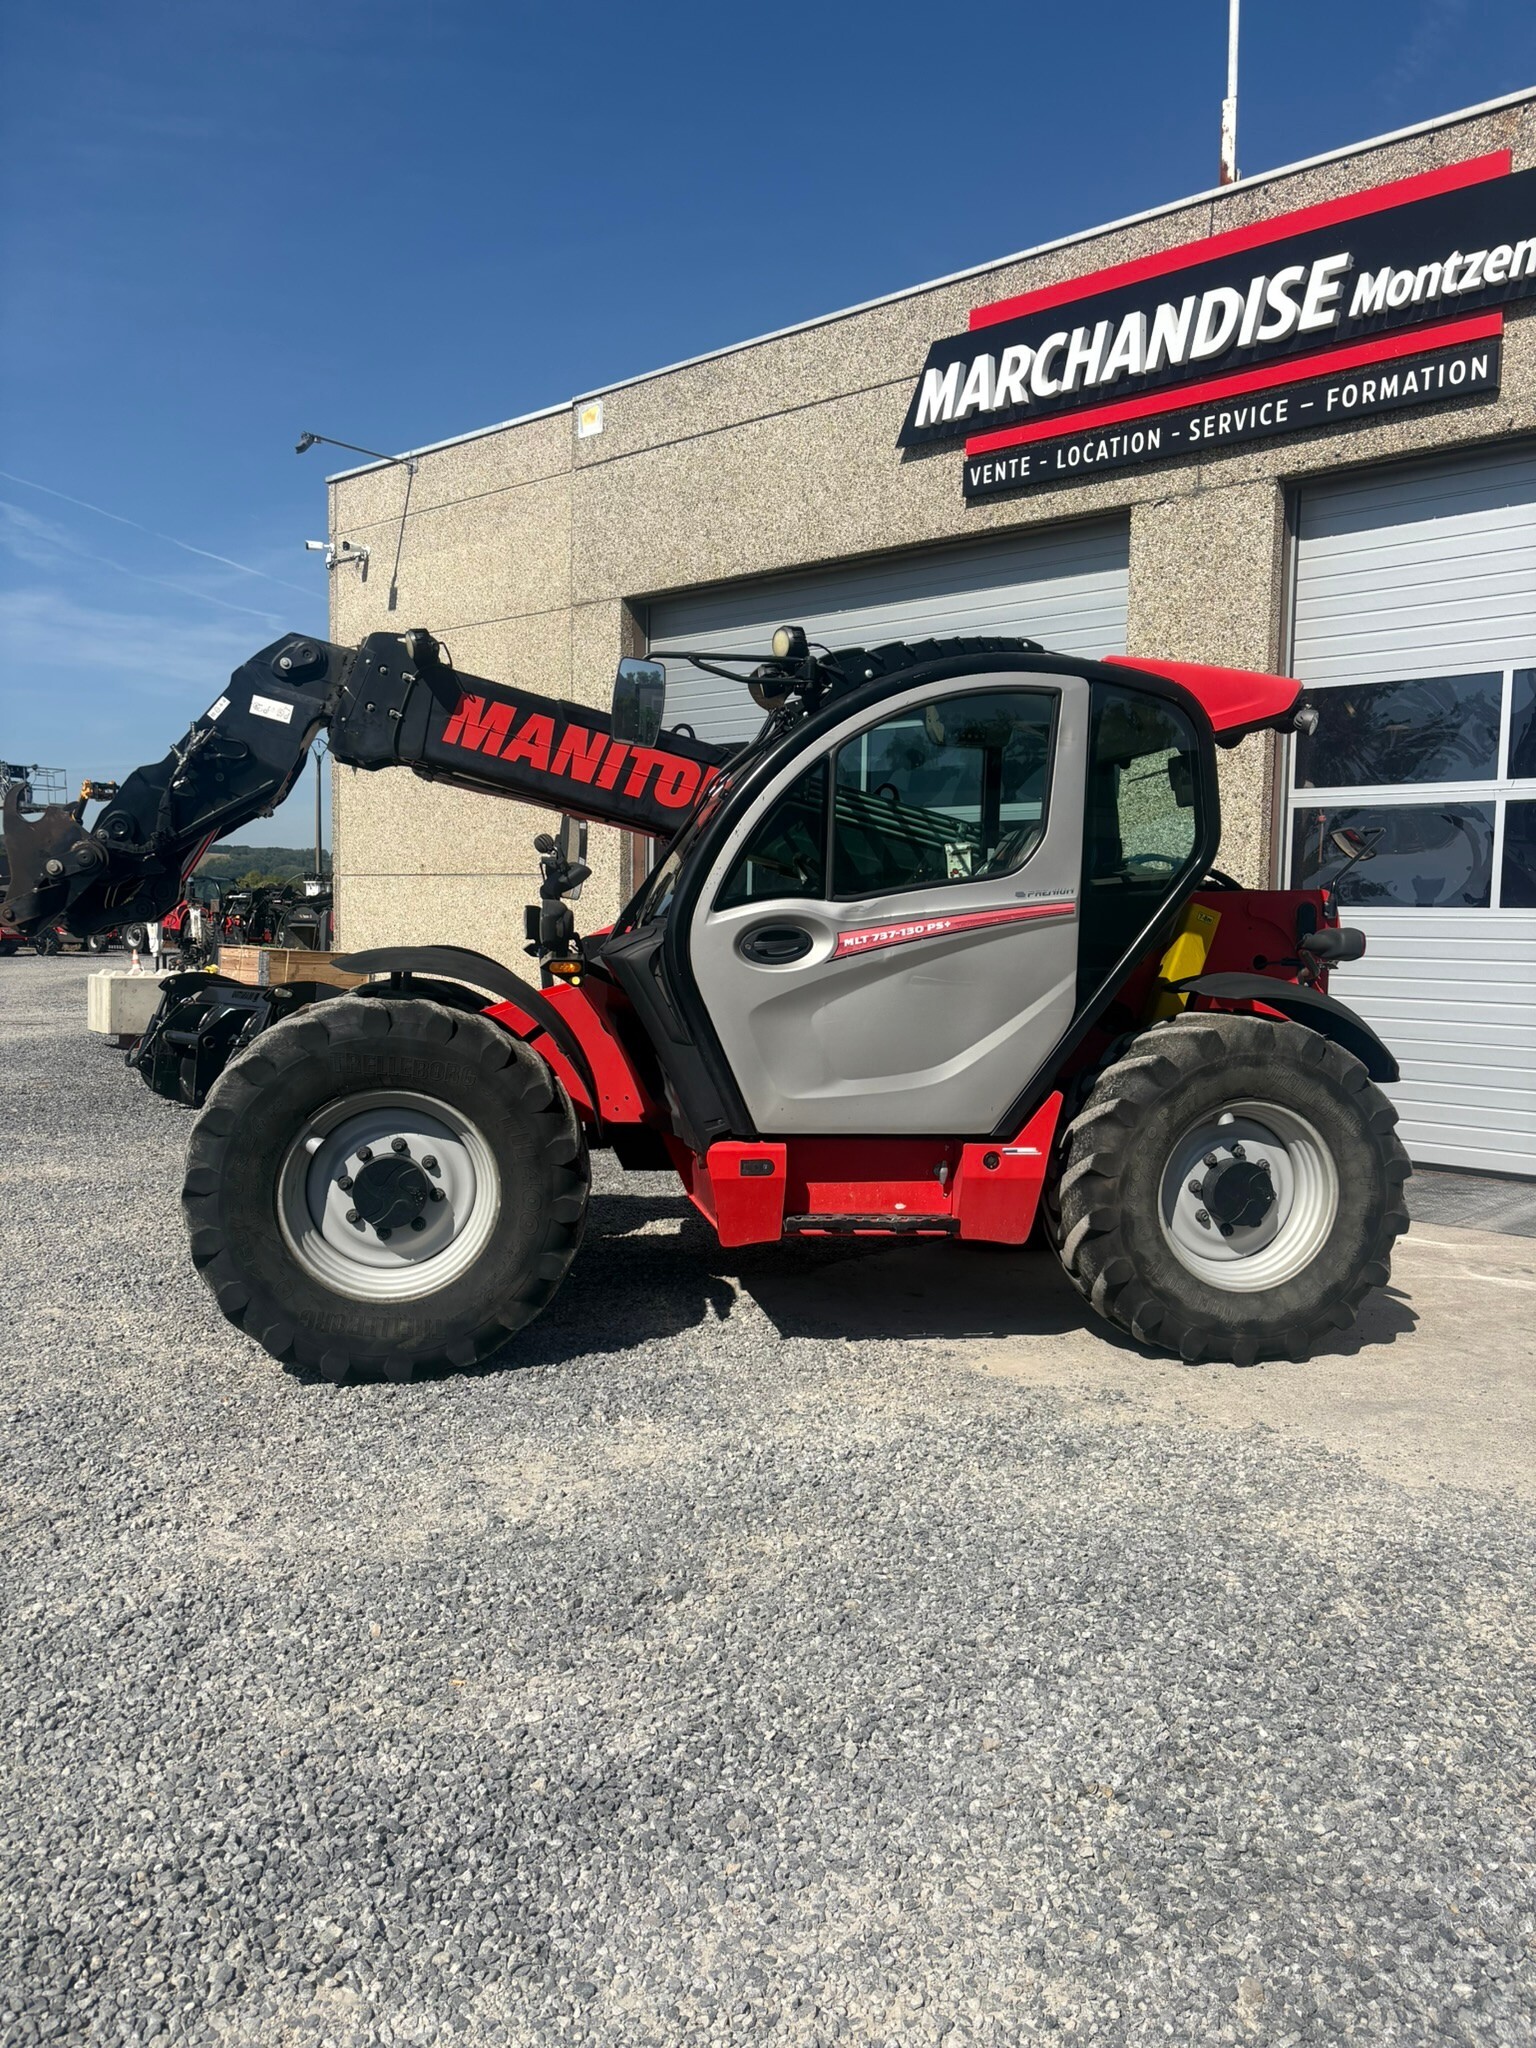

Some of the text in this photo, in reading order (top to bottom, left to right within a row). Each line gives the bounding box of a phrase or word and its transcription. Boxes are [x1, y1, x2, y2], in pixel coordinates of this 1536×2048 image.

[914, 237, 1536, 428] MARCHANDISE Montzen
[970, 458, 1031, 486] VENTE
[1057, 428, 1161, 468] LOCATION
[1189, 400, 1288, 441] SERVICE
[1326, 354, 1489, 412] FORMATION
[844, 921, 951, 947] MLT 737-130 PS+
[331, 1052, 477, 1087] TRELLEBORG
